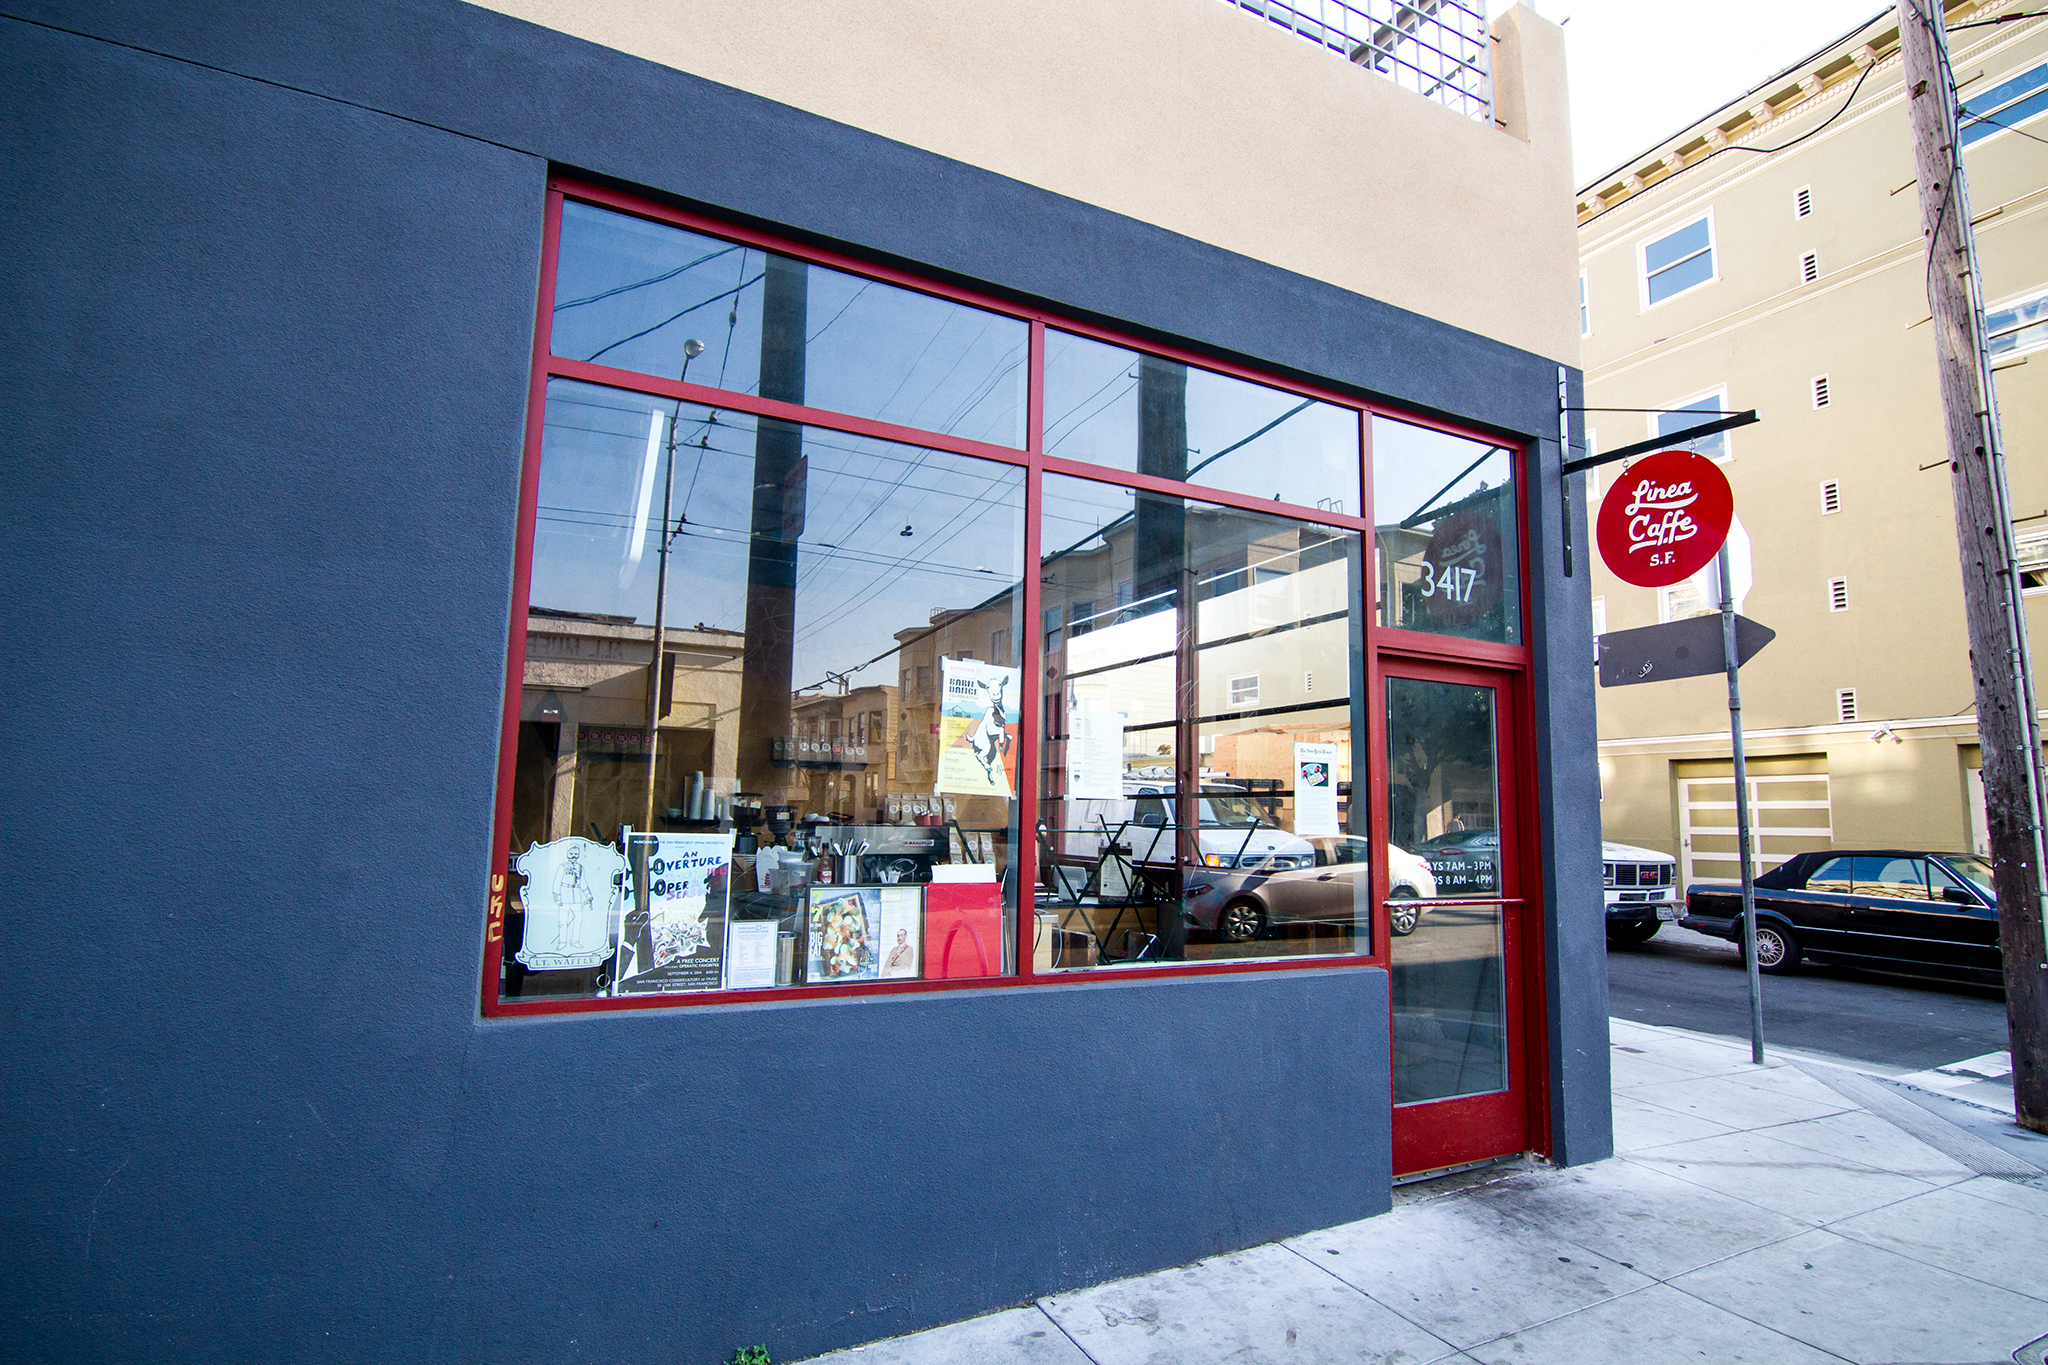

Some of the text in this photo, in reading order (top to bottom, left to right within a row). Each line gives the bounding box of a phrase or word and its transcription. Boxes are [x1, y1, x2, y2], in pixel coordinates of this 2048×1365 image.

[1625, 479, 1698, 516] Linea
[1628, 510, 1698, 554] Caffe
[1649, 549, 1676, 567] S.F.
[1420, 560, 1478, 603] 3417
[949, 678, 974, 688] BARN
[949, 686, 979, 696] DANCE
[653, 856, 722, 875] OVERTURE
[1640, 871, 1658, 879] GMC
[653, 878, 700, 896] OPERA
[666, 886, 712, 901] SEASON
[811, 890, 824, 904] 7
[811, 906, 824, 922] 7
[810, 932, 823, 944] BIG
[810, 944, 822, 957] EAT
[534, 956, 596, 966] LT. WAFFLE
